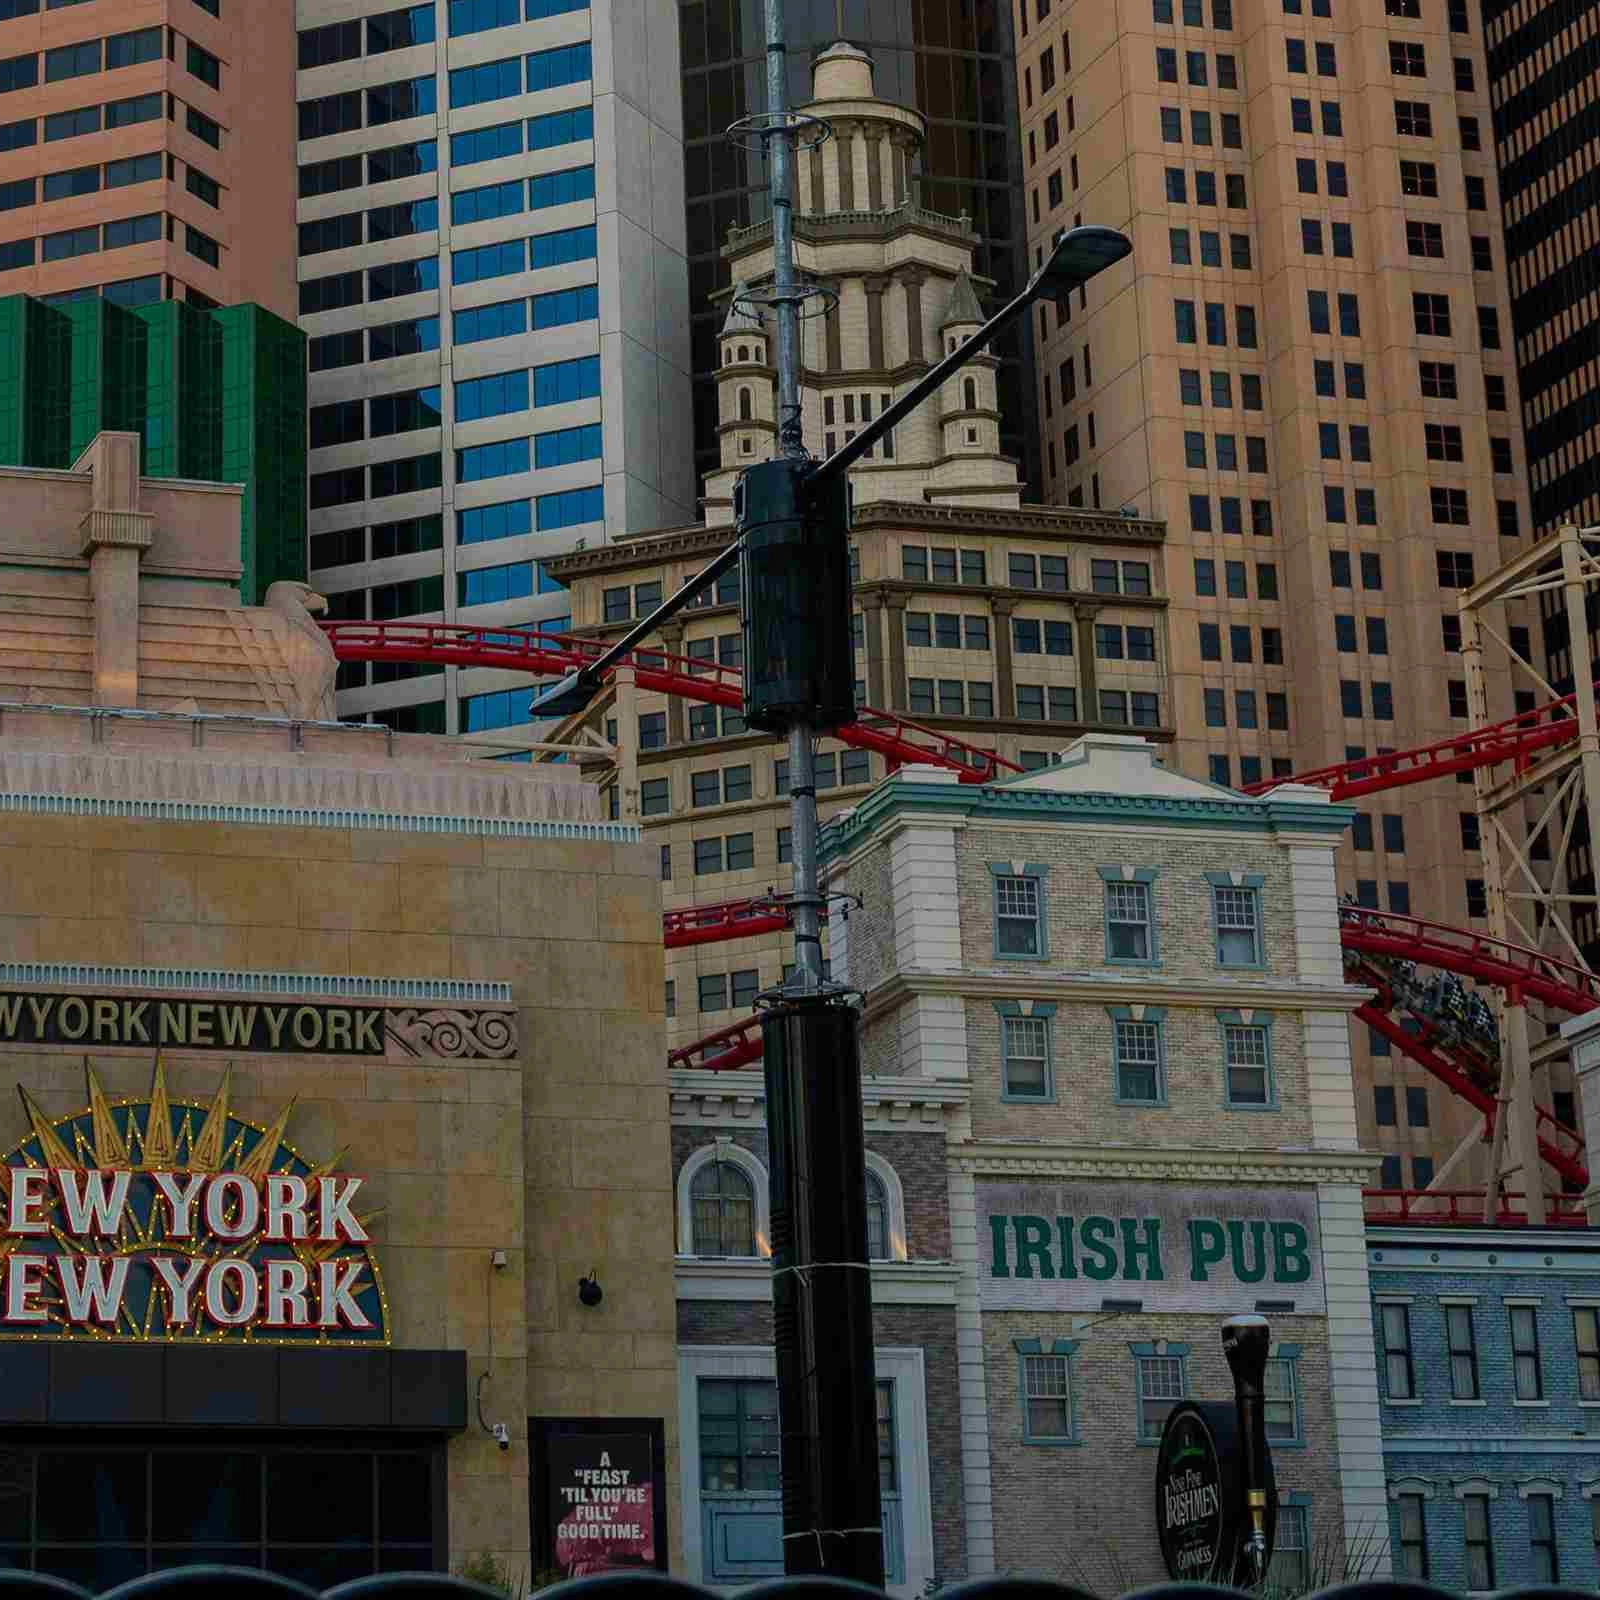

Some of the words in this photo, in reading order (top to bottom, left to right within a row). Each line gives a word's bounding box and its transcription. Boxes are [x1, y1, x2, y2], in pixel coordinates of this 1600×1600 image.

[152, 1172, 372, 1243] YORK
[990, 1215, 1163, 1280] IRISH
[1188, 1220, 1311, 1283] PUB
[150, 1257, 373, 1328] YORK
[600, 1451, 611, 1467] A
[575, 1469, 630, 1485] "FEAST
[561, 1488, 588, 1503] 'TIL
[591, 1488, 646, 1503] YOU'RE
[576, 1506, 618, 1521] FULL"
[557, 1524, 599, 1539] GOOD
[601, 1524, 645, 1539] TIME.
